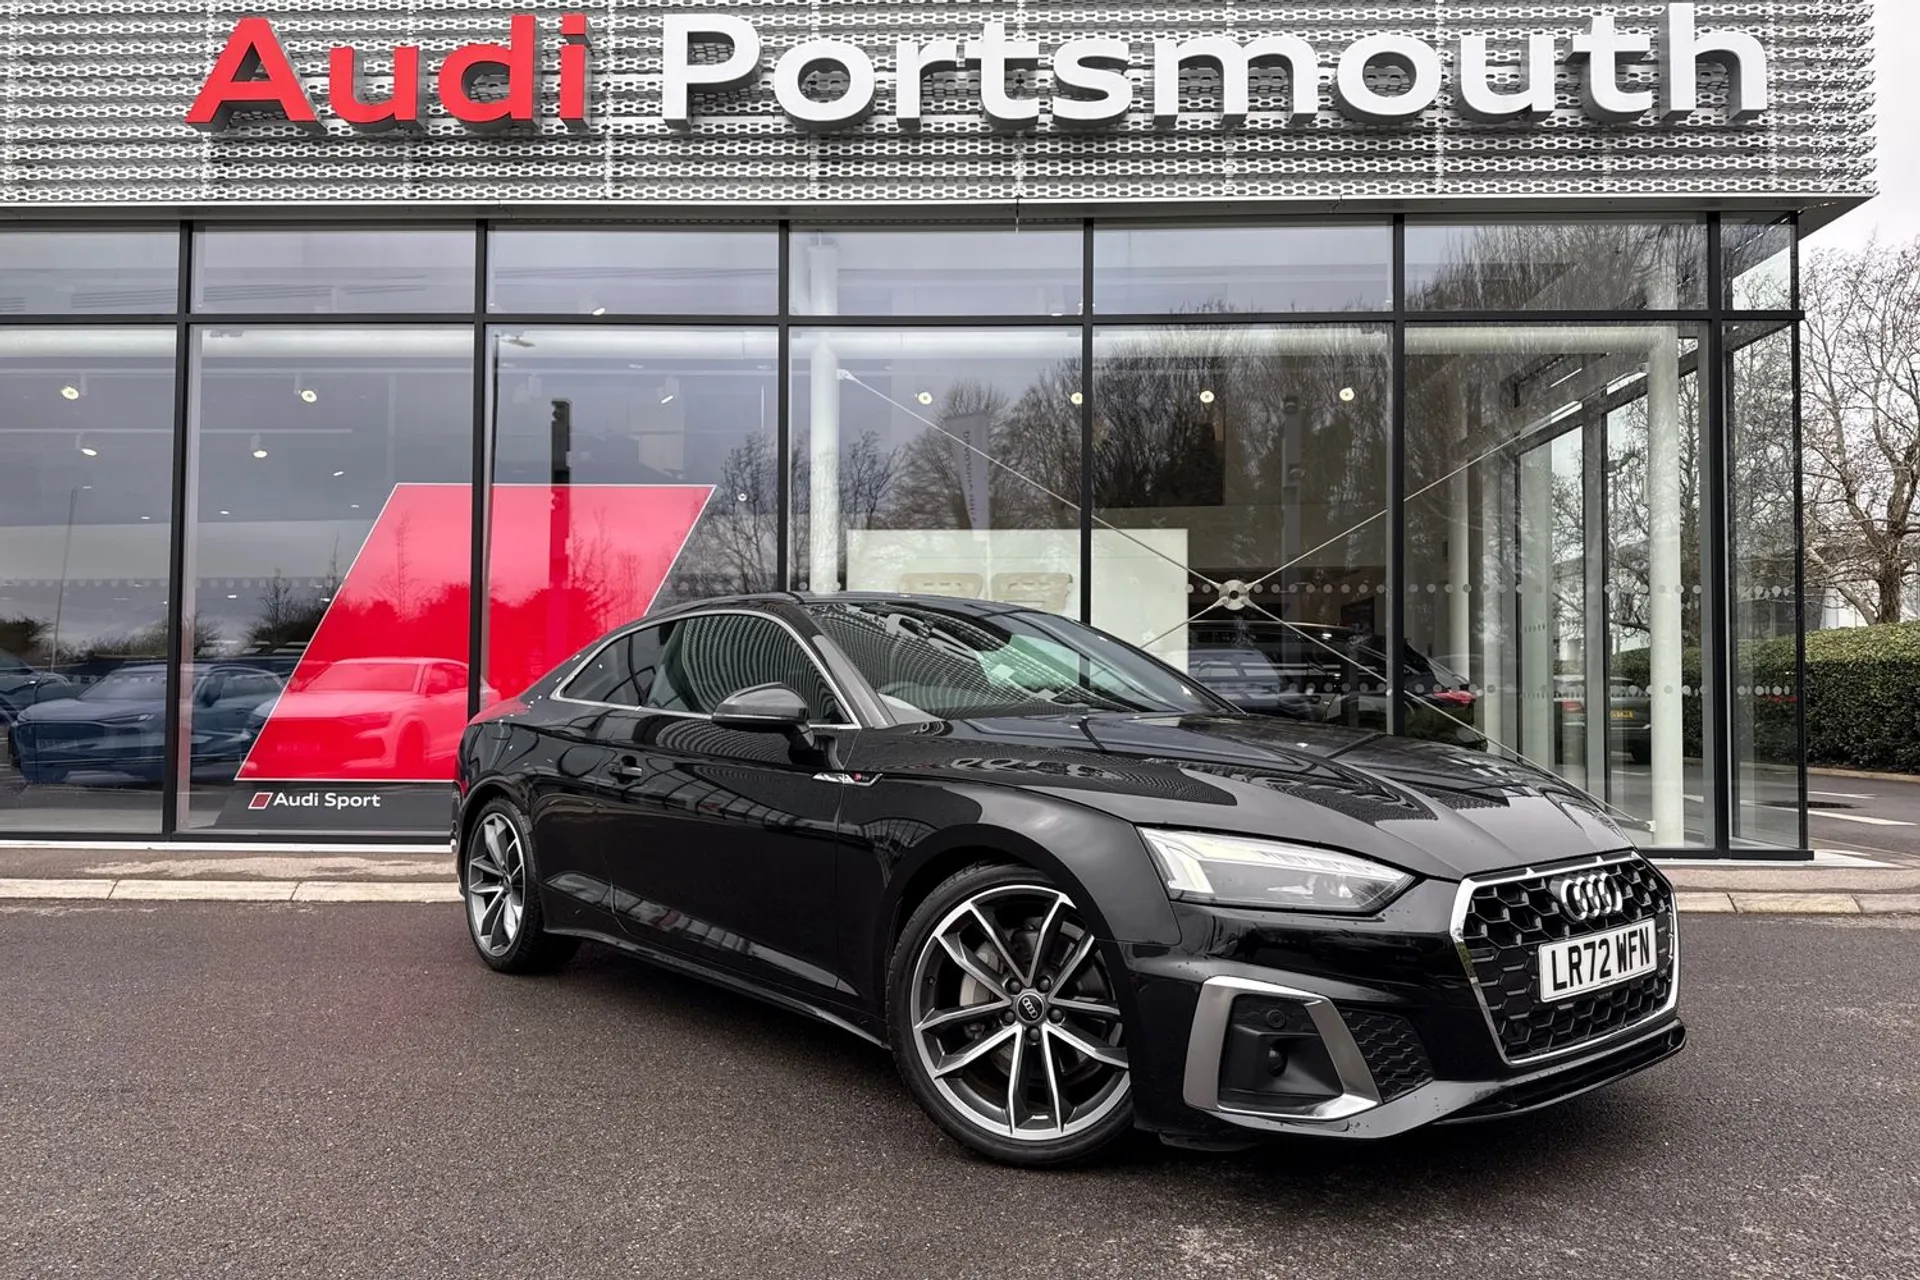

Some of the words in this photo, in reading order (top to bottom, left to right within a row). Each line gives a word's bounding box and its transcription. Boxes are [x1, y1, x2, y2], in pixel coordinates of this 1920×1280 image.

[184, 13, 588, 126] Audi
[661, 2, 1769, 126] Portsmouth
[273, 792, 319, 807] Audi
[324, 792, 381, 810] Sport
[1551, 938, 1612, 992] LR72
[1616, 926, 1650, 974] WFN
